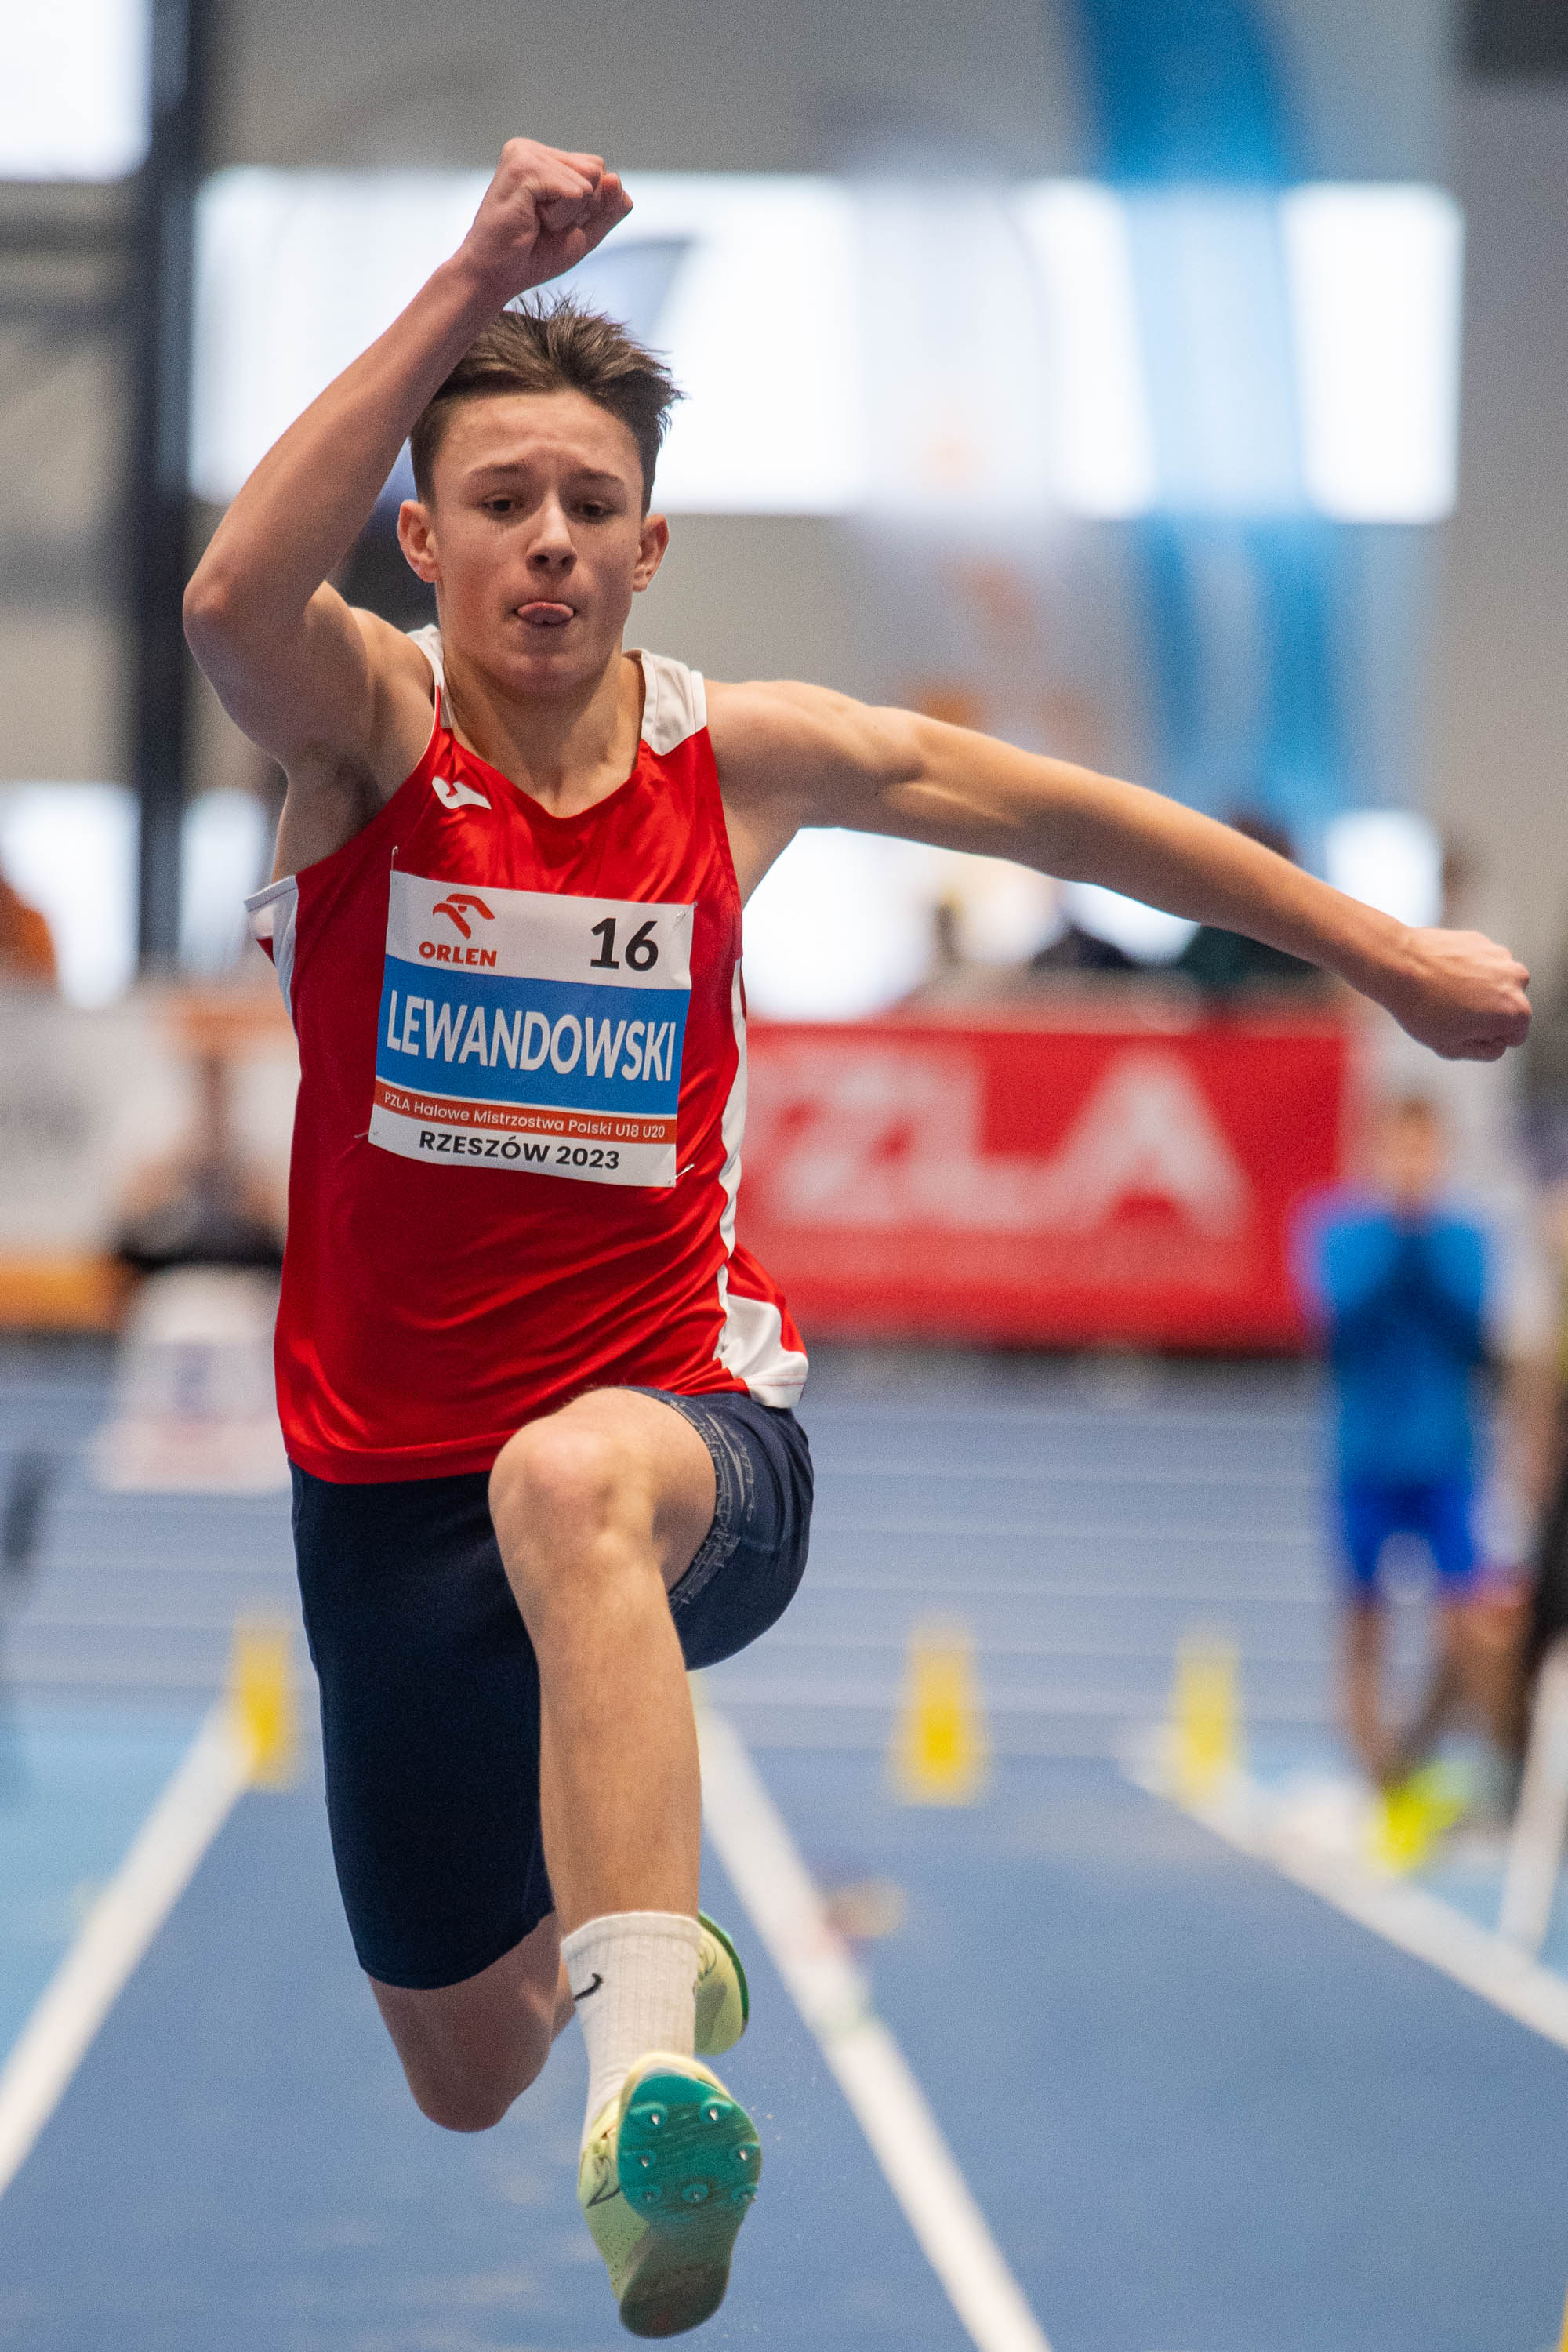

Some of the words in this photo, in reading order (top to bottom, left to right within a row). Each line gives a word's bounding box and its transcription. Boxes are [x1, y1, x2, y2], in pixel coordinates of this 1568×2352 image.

[419, 941, 497, 967] ORLEN
[590, 917, 659, 971] 16
[387, 989, 676, 1082] LEWANDOWSKI
[384, 1092, 410, 1112] PZLA
[414, 1102, 470, 1121] Halowe
[474, 1109, 564, 1131] Mistrzostwa
[568, 1120, 611, 1136] Polski
[615, 1124, 638, 1137] U18
[642, 1126, 666, 1138] U20
[419, 1130, 551, 1162] RZESZÓW
[555, 1145, 619, 1170] 2023
